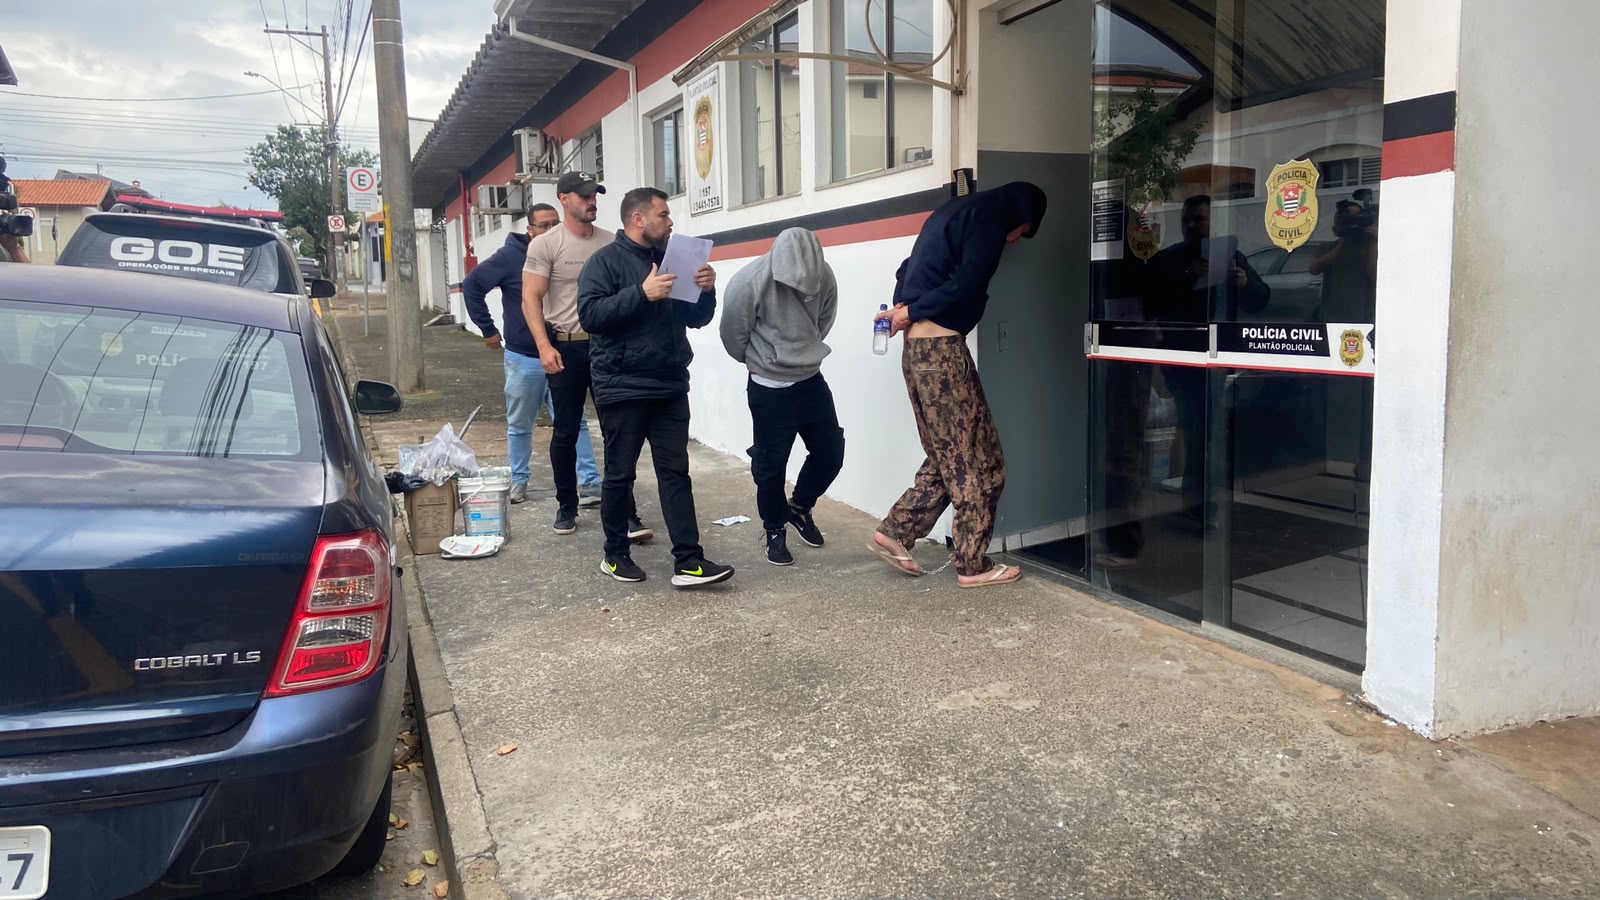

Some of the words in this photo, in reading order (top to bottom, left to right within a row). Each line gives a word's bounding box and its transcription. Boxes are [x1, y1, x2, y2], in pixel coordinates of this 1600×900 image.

[358, 174, 366, 186] E
[1277, 169, 1308, 183] POLÍCIA
[1278, 228, 1303, 238] CIVIL
[110, 236, 245, 270] GOE
[118, 261, 180, 271] OPERAÇÕES
[183, 266, 235, 277] ESPECIAIS
[1242, 325, 1288, 340] POLÍCIA
[1290, 328, 1323, 341] CIVIL
[1248, 341, 1281, 351] PLANTÃO
[1281, 343, 1315, 352] POLICIAL
[135, 353, 189, 367] POLÍ
[134, 653, 227, 671] COBALT
[233, 650, 261, 665] LS
[0, 853, 34, 891] 7
